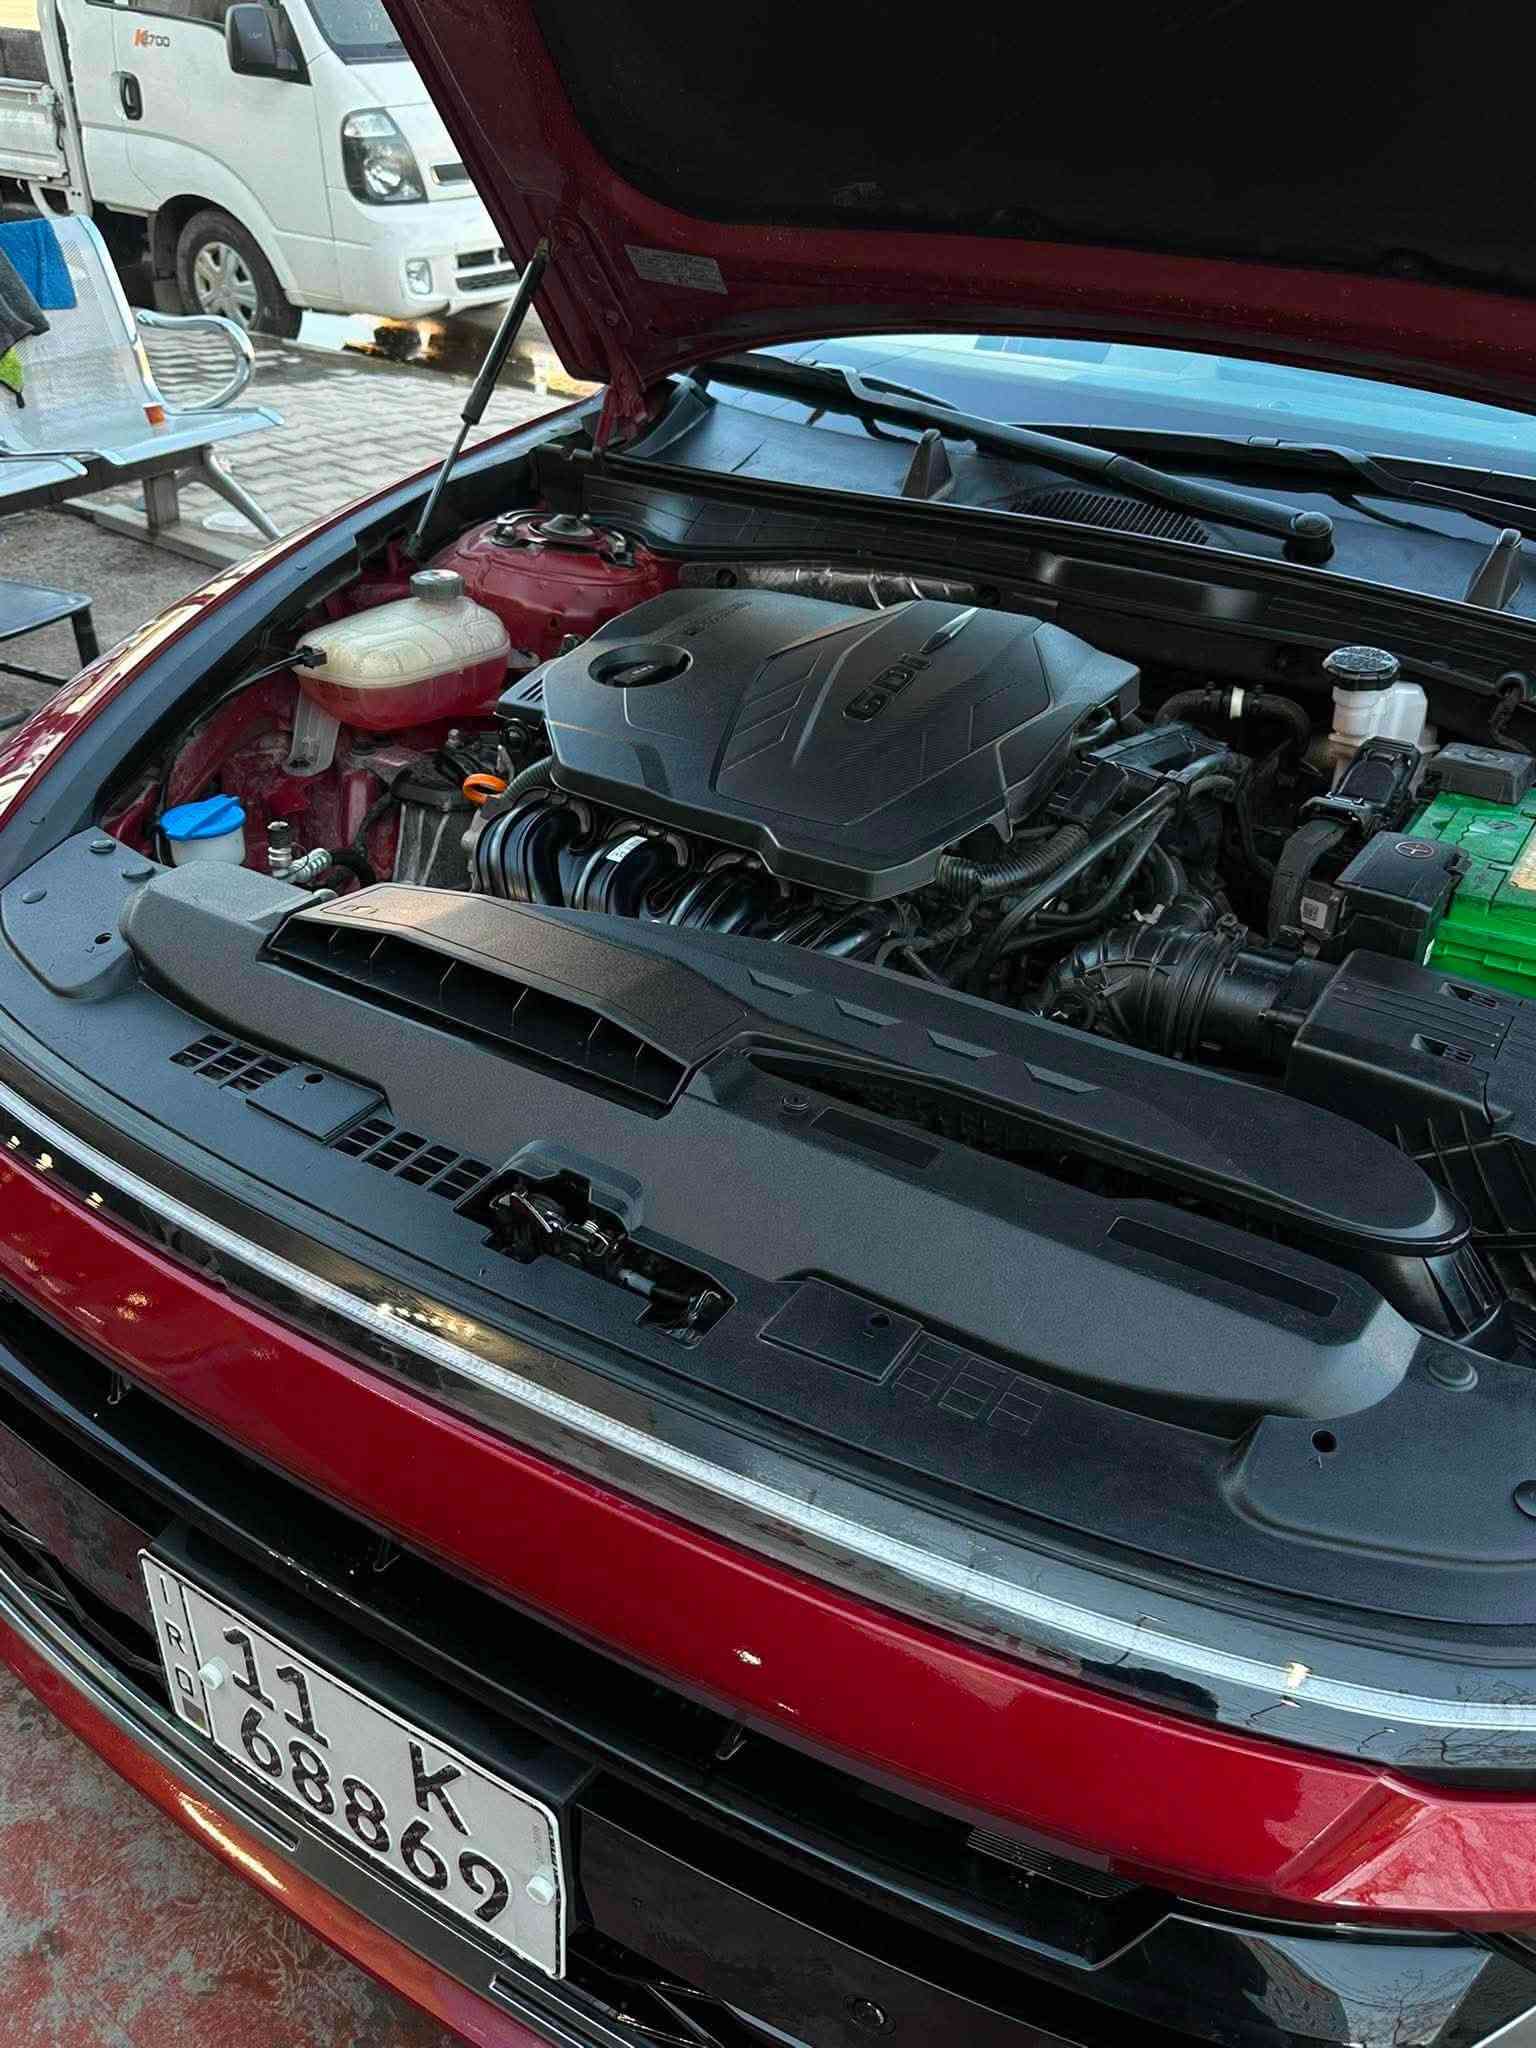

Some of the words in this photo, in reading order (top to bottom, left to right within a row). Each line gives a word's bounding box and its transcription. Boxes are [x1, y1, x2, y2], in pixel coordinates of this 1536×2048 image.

[223, 1628, 329, 1749] 11
[409, 1740, 469, 1836] K
[241, 1706, 508, 1924] 68869
